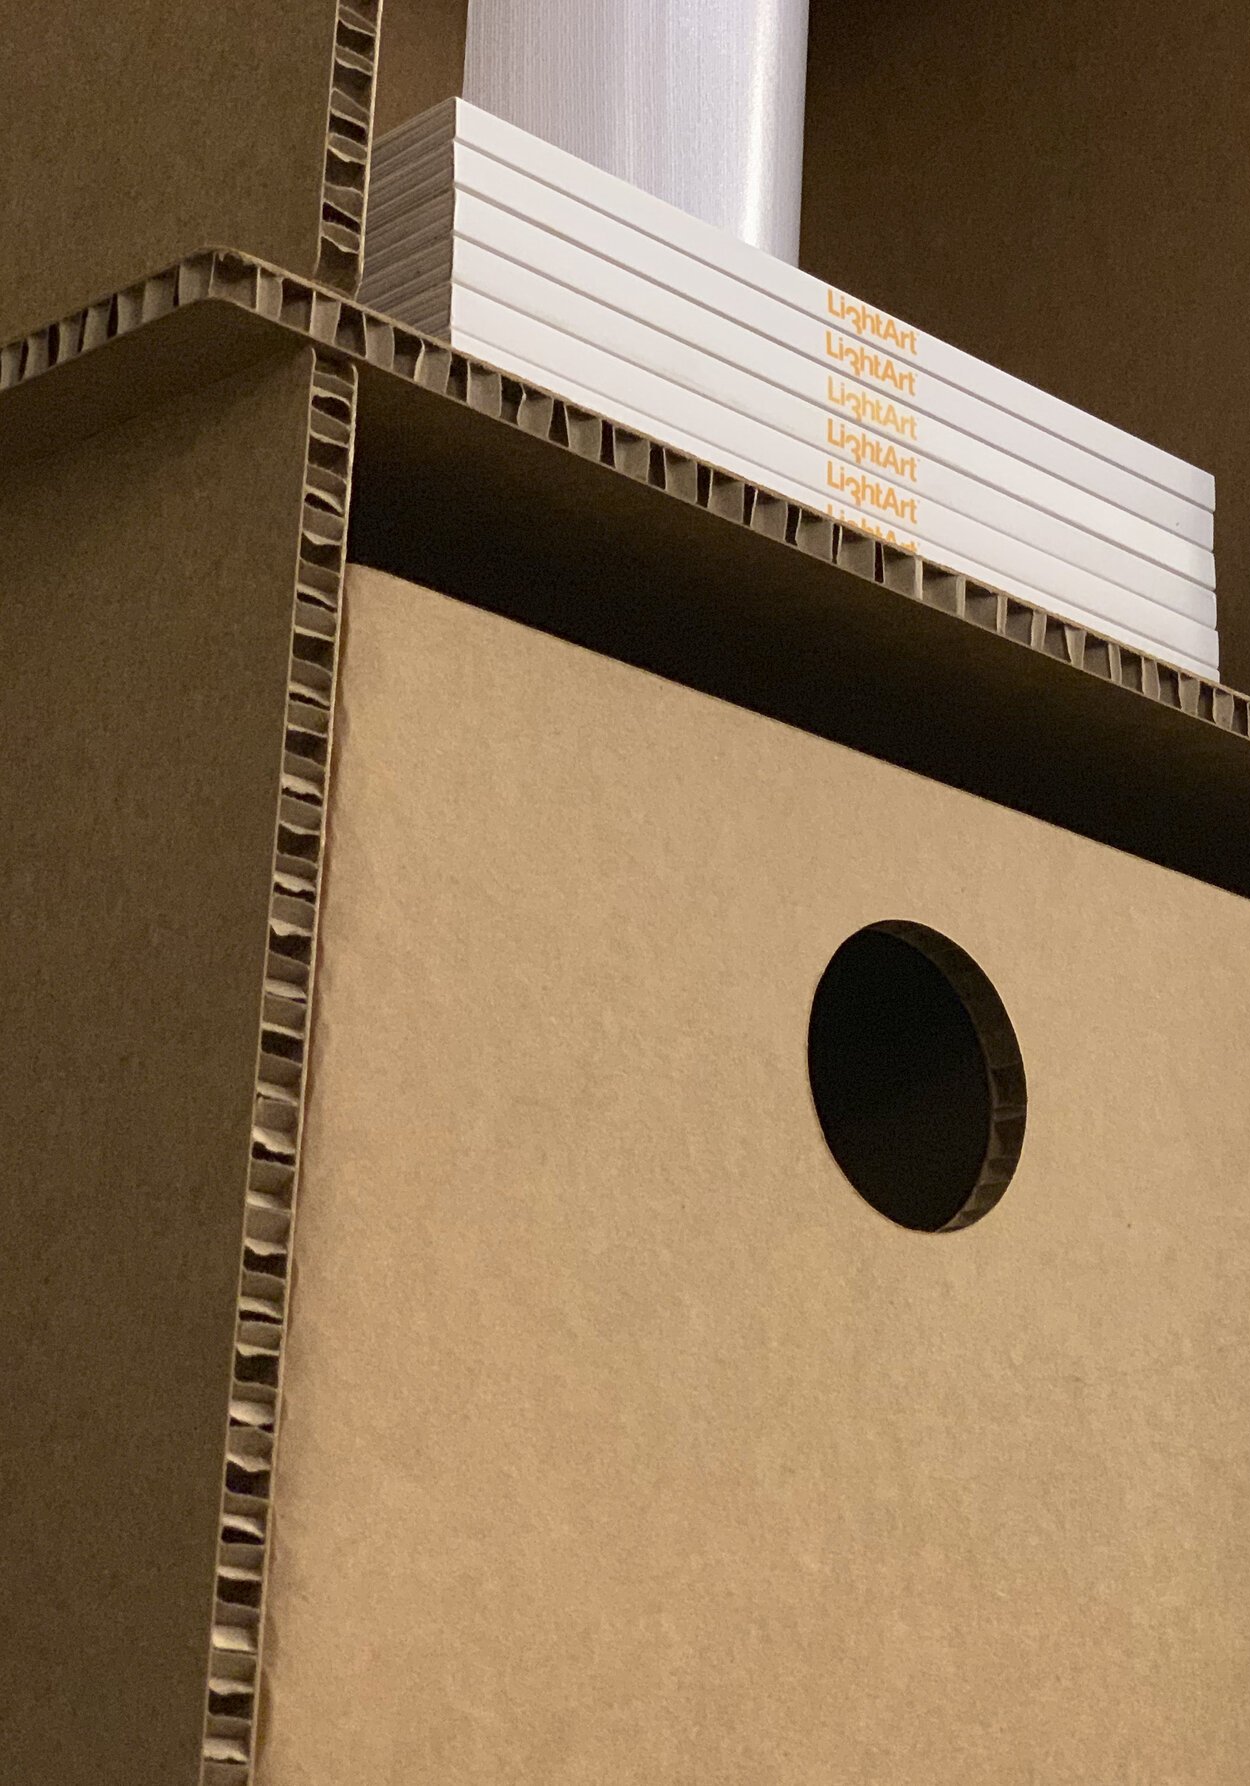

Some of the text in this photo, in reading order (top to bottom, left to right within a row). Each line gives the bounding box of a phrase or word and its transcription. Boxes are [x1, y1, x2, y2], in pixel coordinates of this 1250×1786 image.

[827, 288, 917, 355] LightArt
[826, 331, 916, 396] LightArt
[828, 375, 917, 440] LightArt
[827, 418, 917, 482] LightArt
[827, 461, 917, 524] LightArt
[827, 504, 918, 552] ihtA
